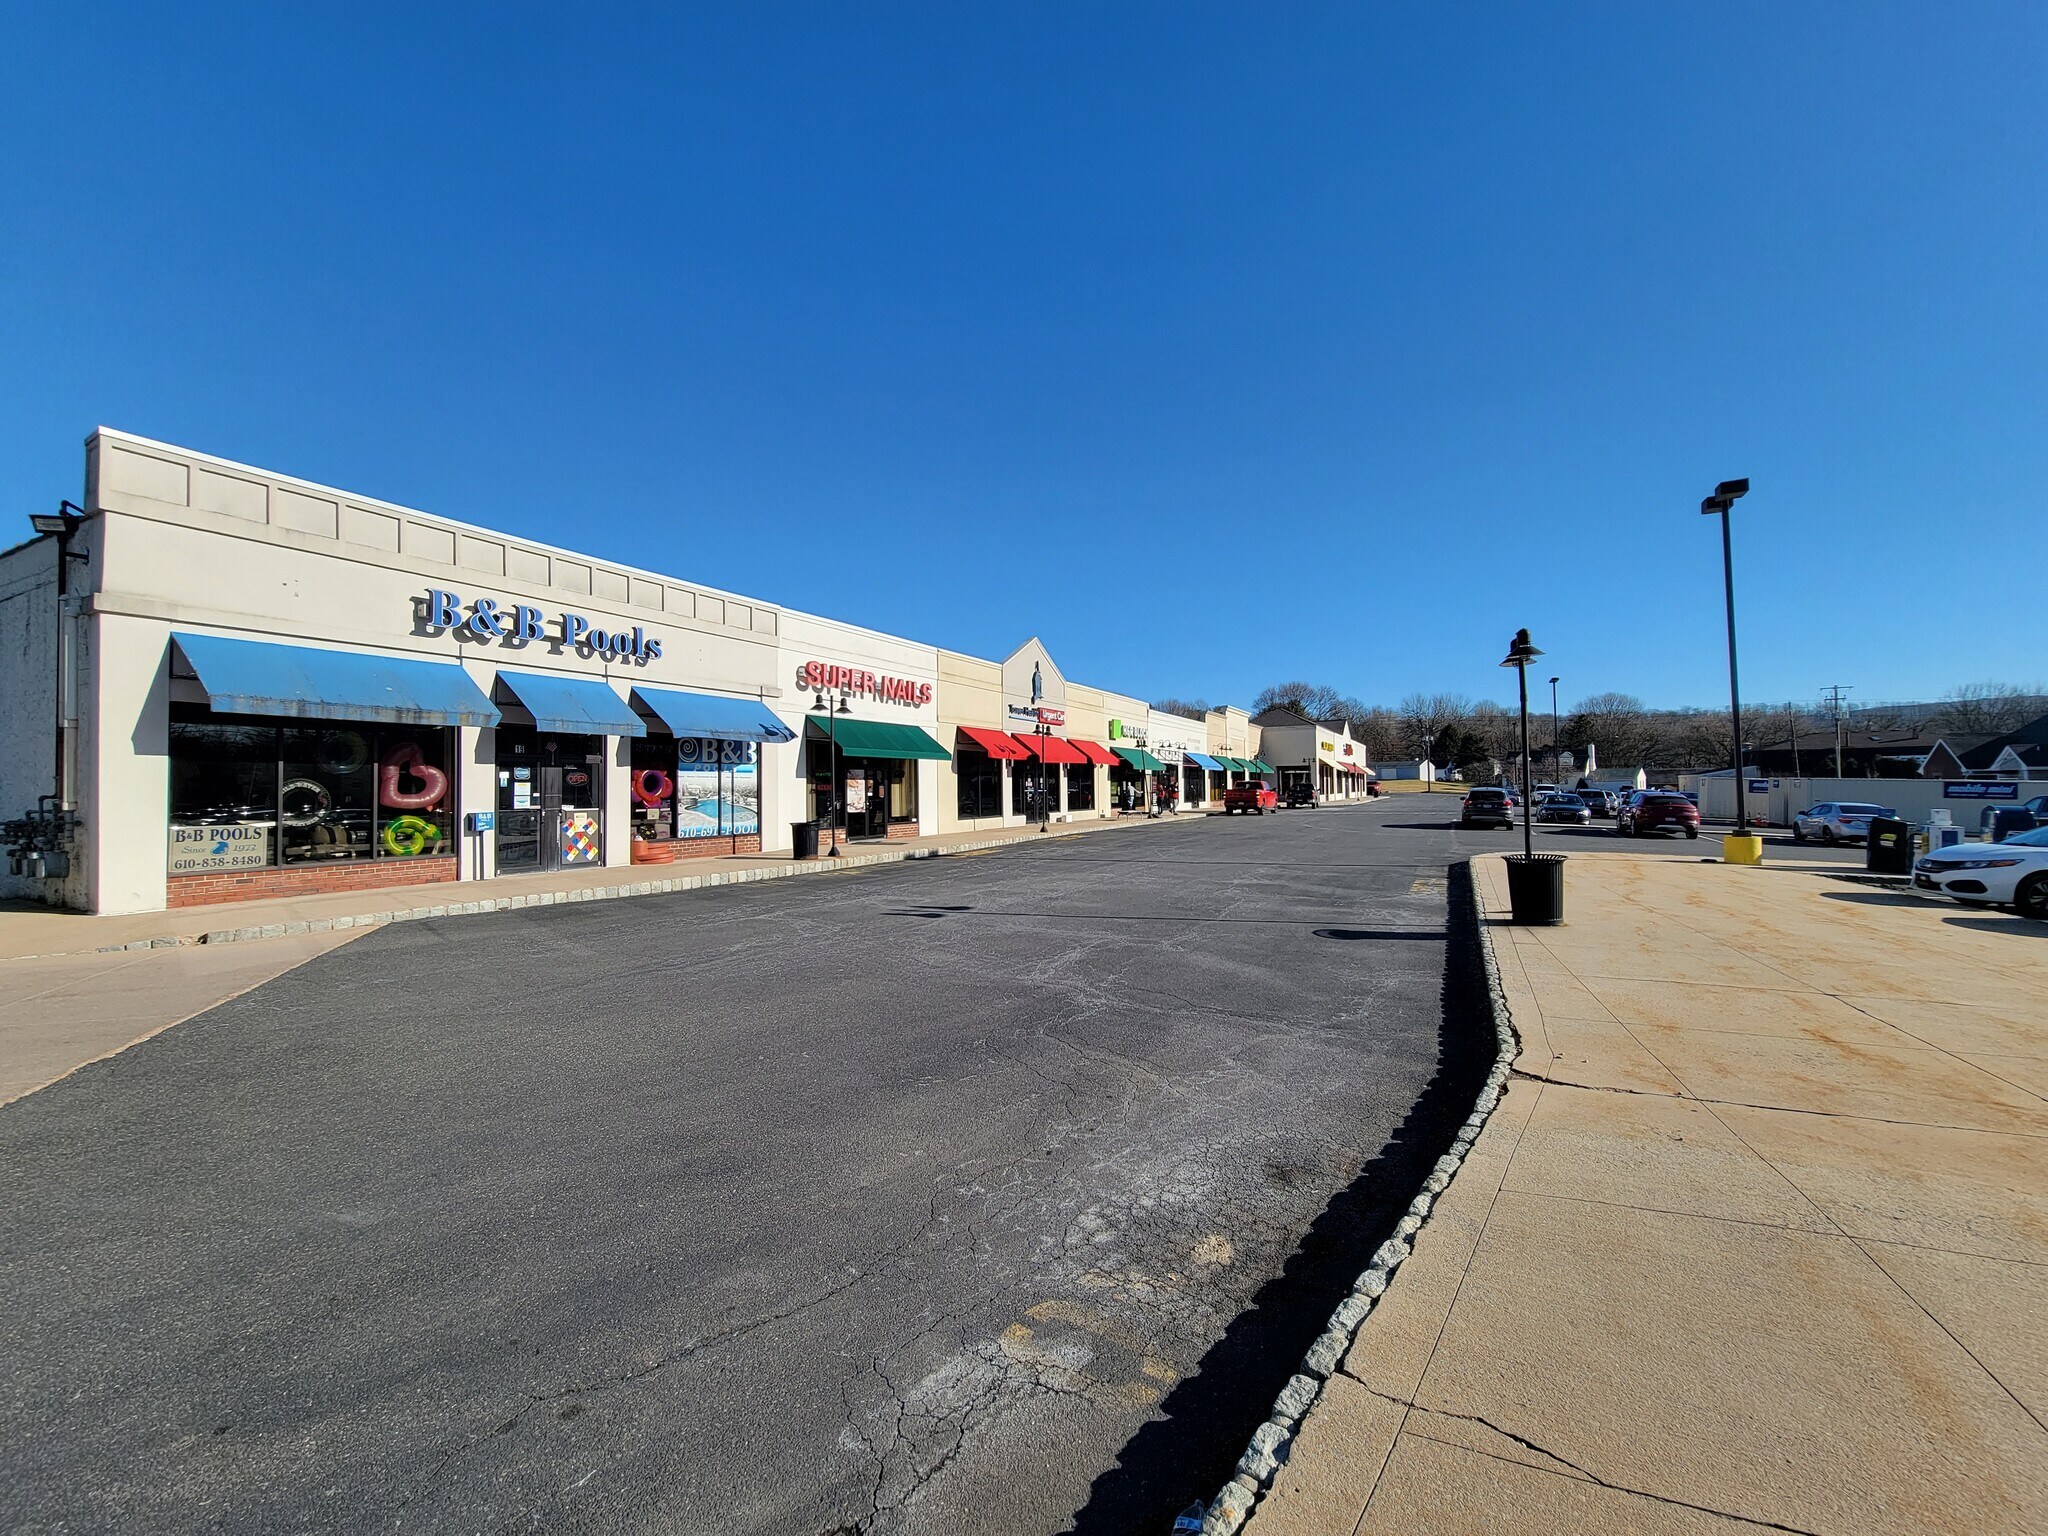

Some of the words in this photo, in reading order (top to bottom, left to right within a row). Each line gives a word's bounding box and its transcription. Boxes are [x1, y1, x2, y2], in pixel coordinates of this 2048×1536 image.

[427, 588, 545, 641] B&B
[559, 613, 663, 660] Pools
[804, 660, 876, 694] SUPER
[881, 675, 933, 705] NAILS
[701, 738, 758, 764] B&B
[1947, 784, 1987, 793] mobile
[1987, 785, 2016, 794] mini
[174, 829, 204, 843] B&B
[209, 827, 262, 842] POOLS
[180, 845, 207, 854] Since
[233, 844, 257, 852] 1973
[174, 855, 261, 869] 610-838-8480
